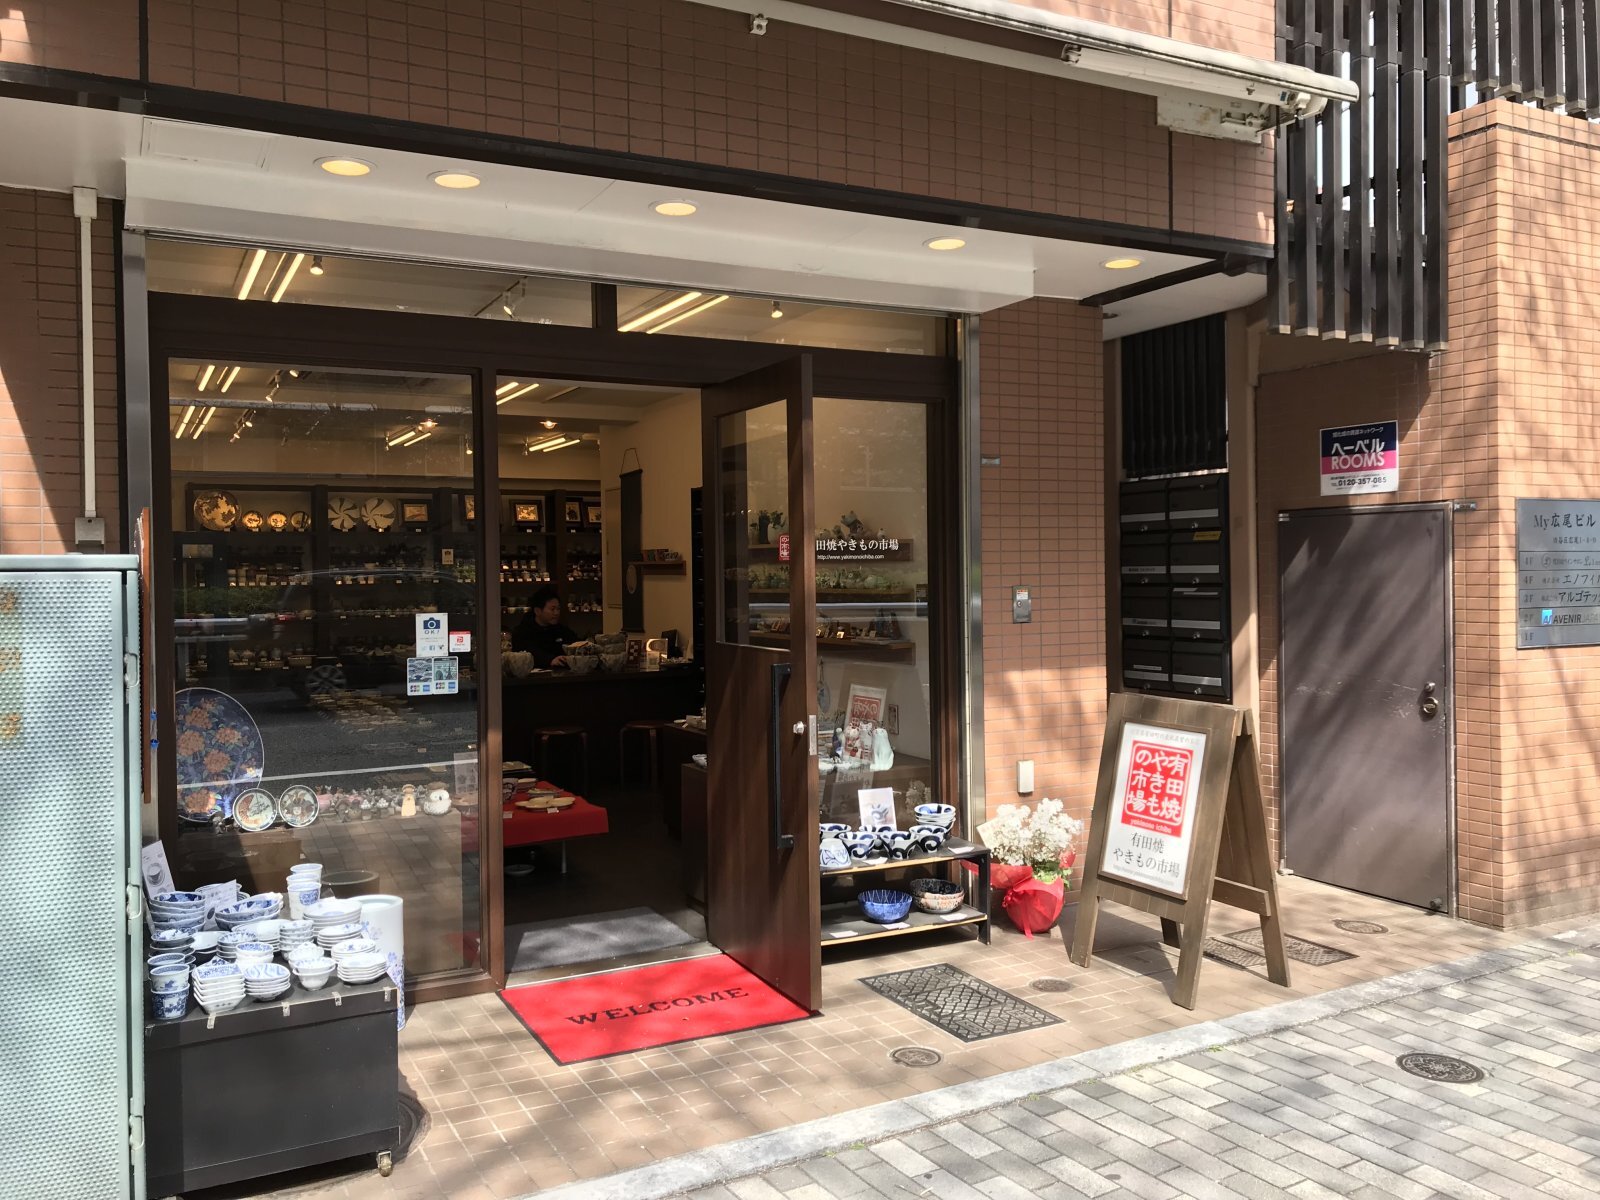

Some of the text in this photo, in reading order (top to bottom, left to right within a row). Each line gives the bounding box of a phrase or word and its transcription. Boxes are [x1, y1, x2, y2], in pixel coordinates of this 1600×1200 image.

[1331, 438, 1386, 456] ヘーベル
[1331, 451, 1385, 471] ROOMS
[1552, 614, 1582, 624] AVENIR
[1131, 832, 1165, 854] 有田焼
[1113, 848, 1181, 878] やきもの市場
[565, 987, 750, 1025] WELCOME
